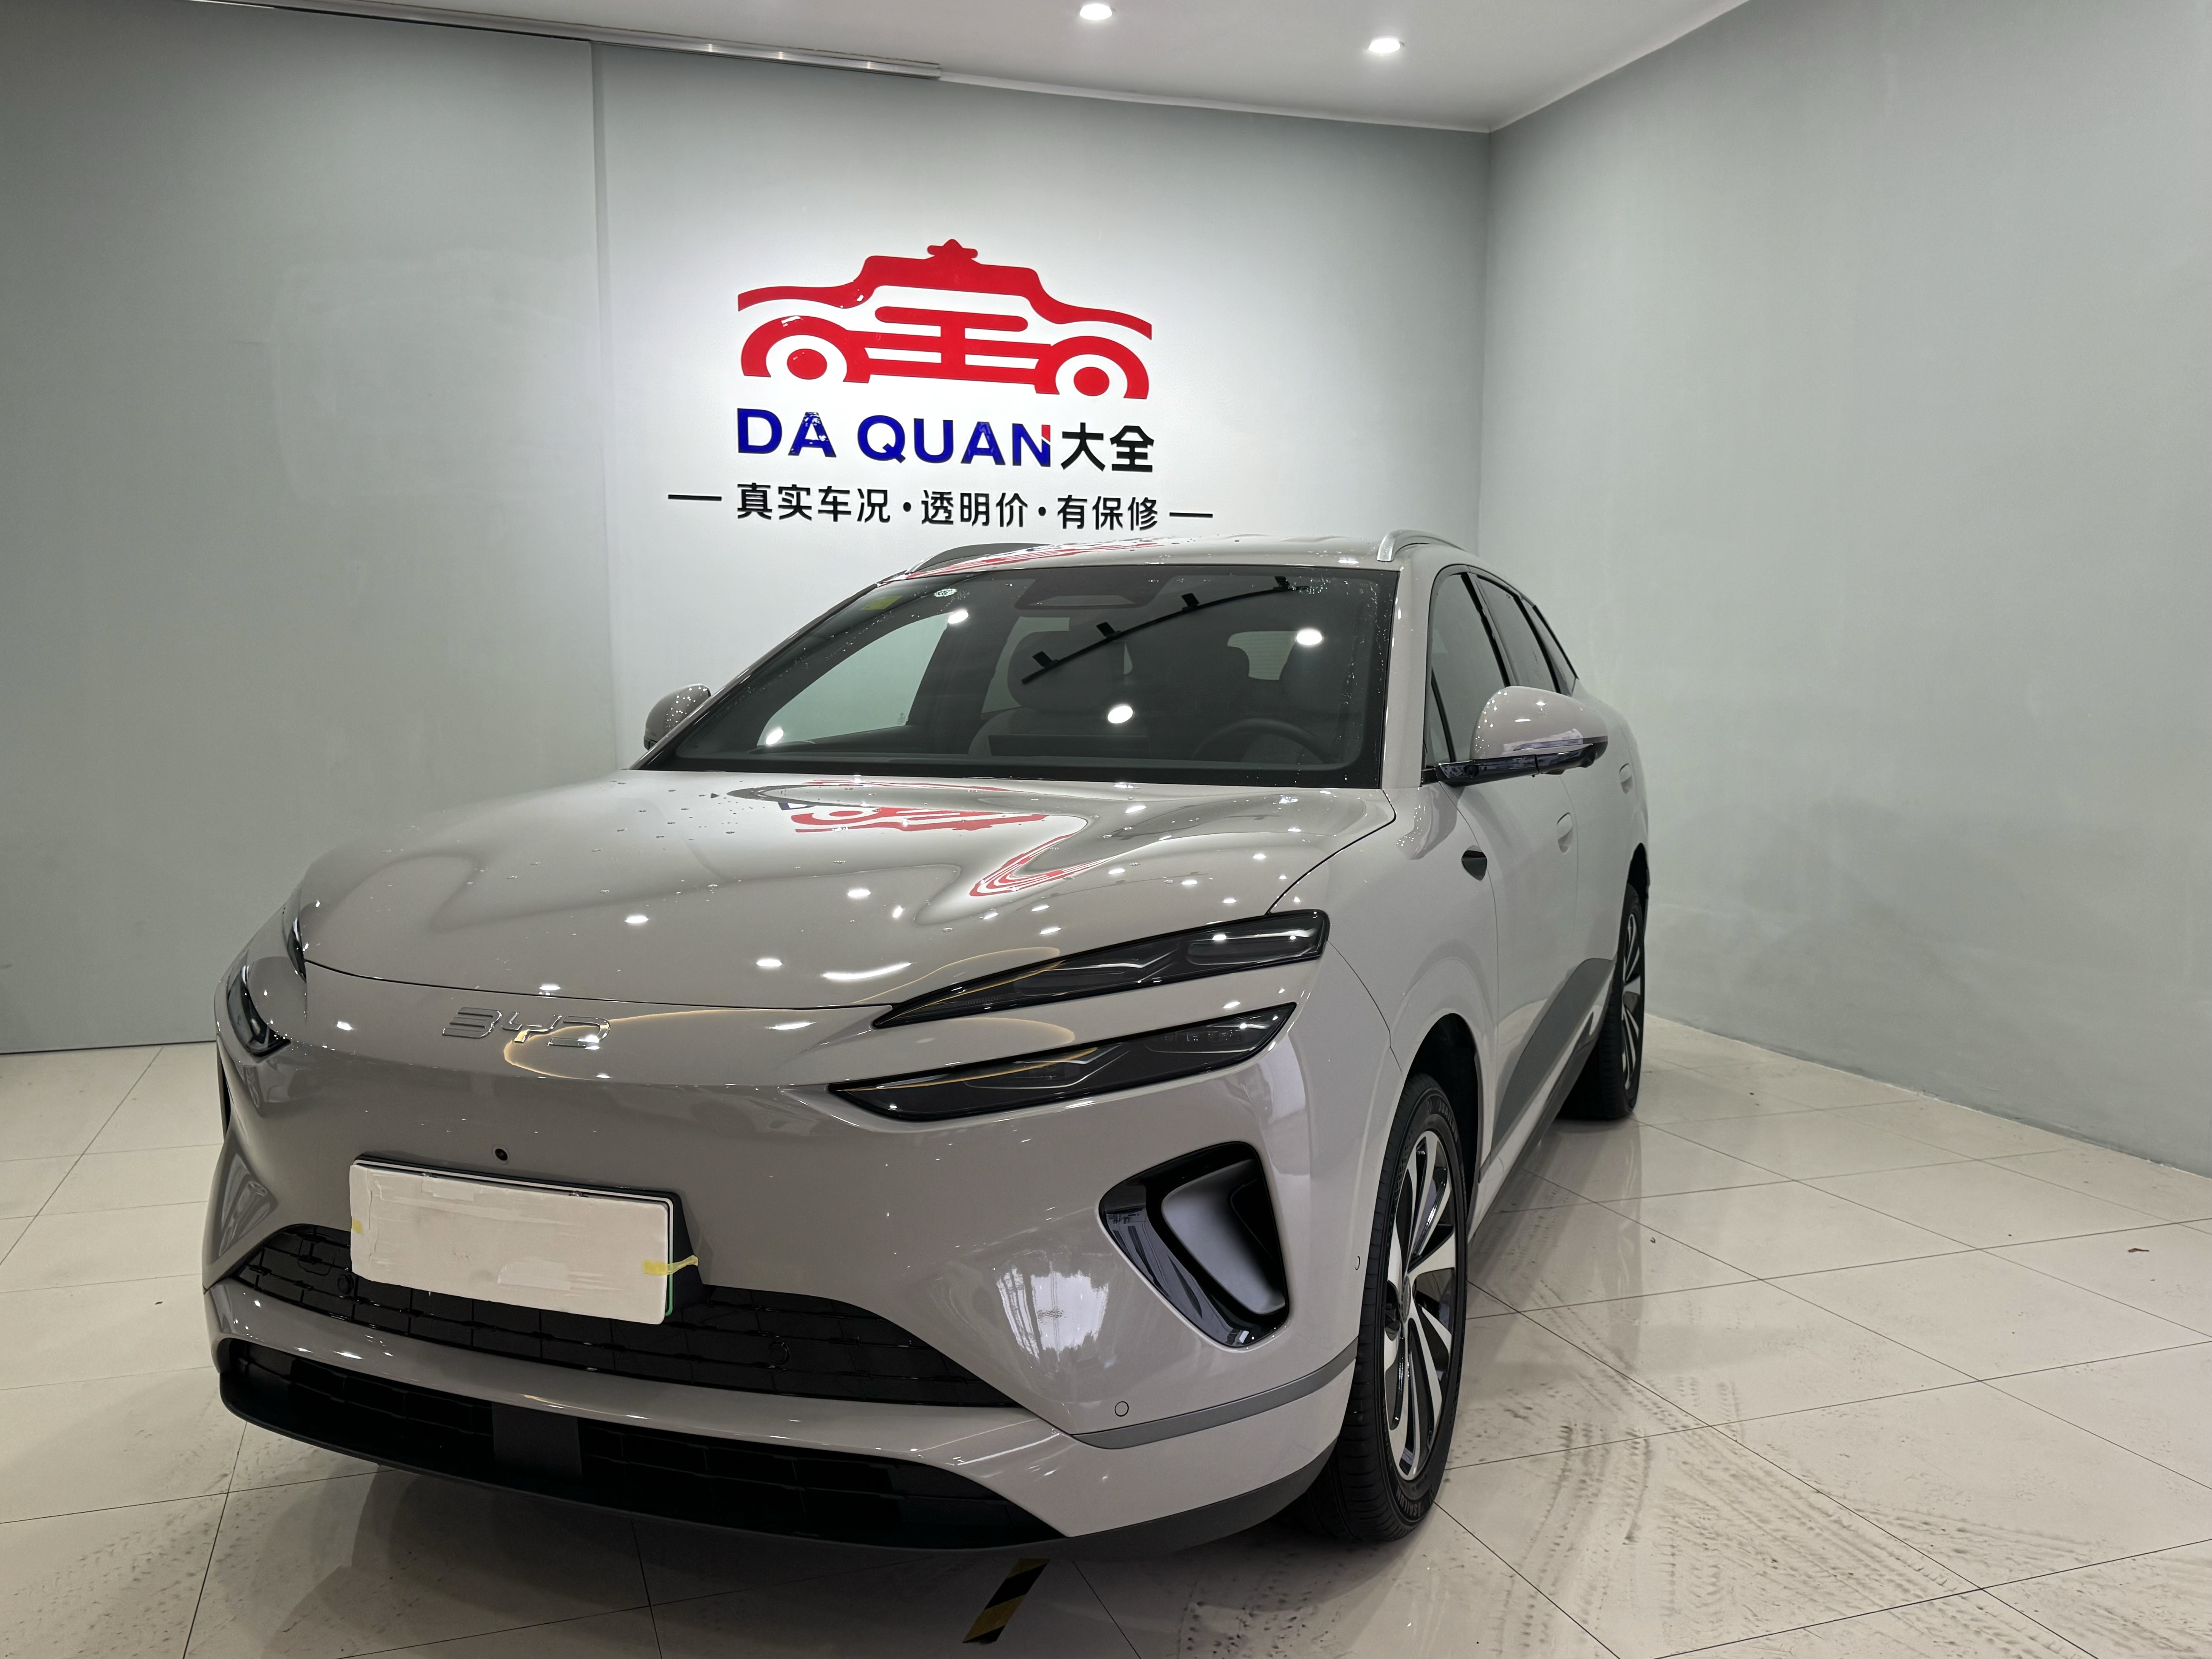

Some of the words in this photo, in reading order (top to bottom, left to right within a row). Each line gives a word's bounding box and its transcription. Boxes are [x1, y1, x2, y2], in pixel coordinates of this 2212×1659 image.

[737, 408, 836, 458] DA
[857, 415, 1051, 467] QUAN
[1061, 422, 1154, 472] 大全
[441, 1007, 611, 1048] BYD
